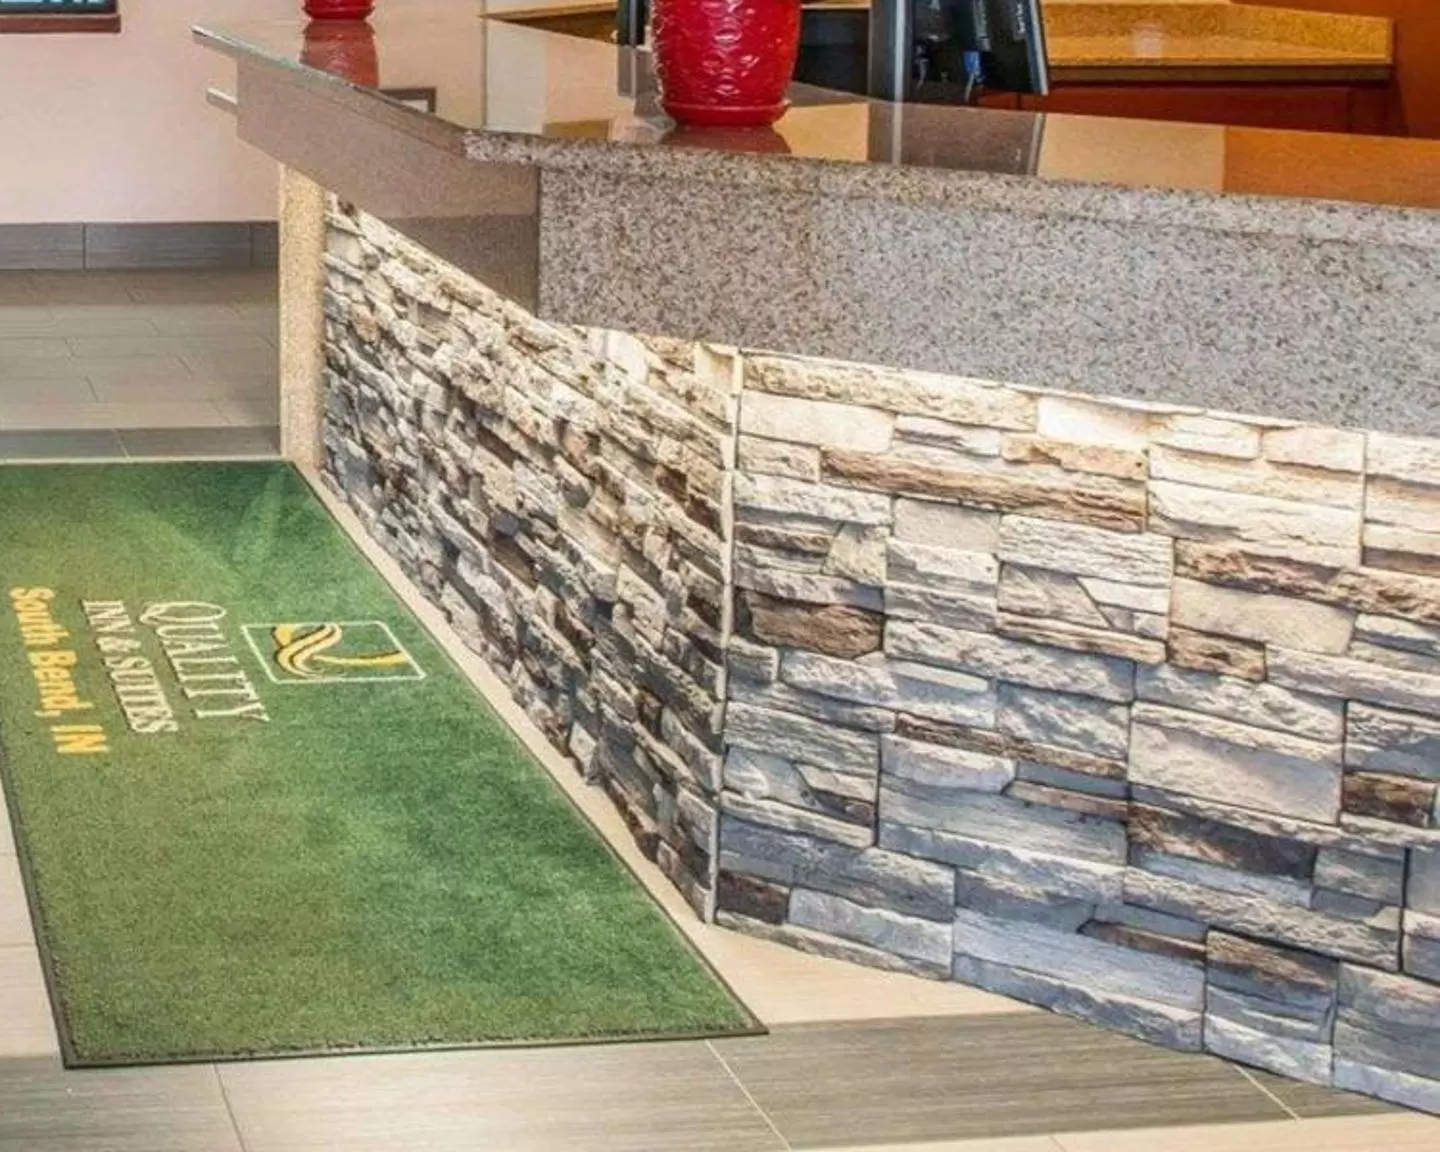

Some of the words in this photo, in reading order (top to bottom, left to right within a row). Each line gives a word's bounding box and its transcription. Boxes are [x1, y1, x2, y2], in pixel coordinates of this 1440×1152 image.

[10, 587, 70, 646] South
[80, 599, 136, 637] INN
[96, 636, 142, 659] &
[139, 601, 270, 722] QUALITY
[27, 649, 93, 719] Bend,
[106, 655, 178, 734] SUITES
[50, 724, 109, 754] IN
